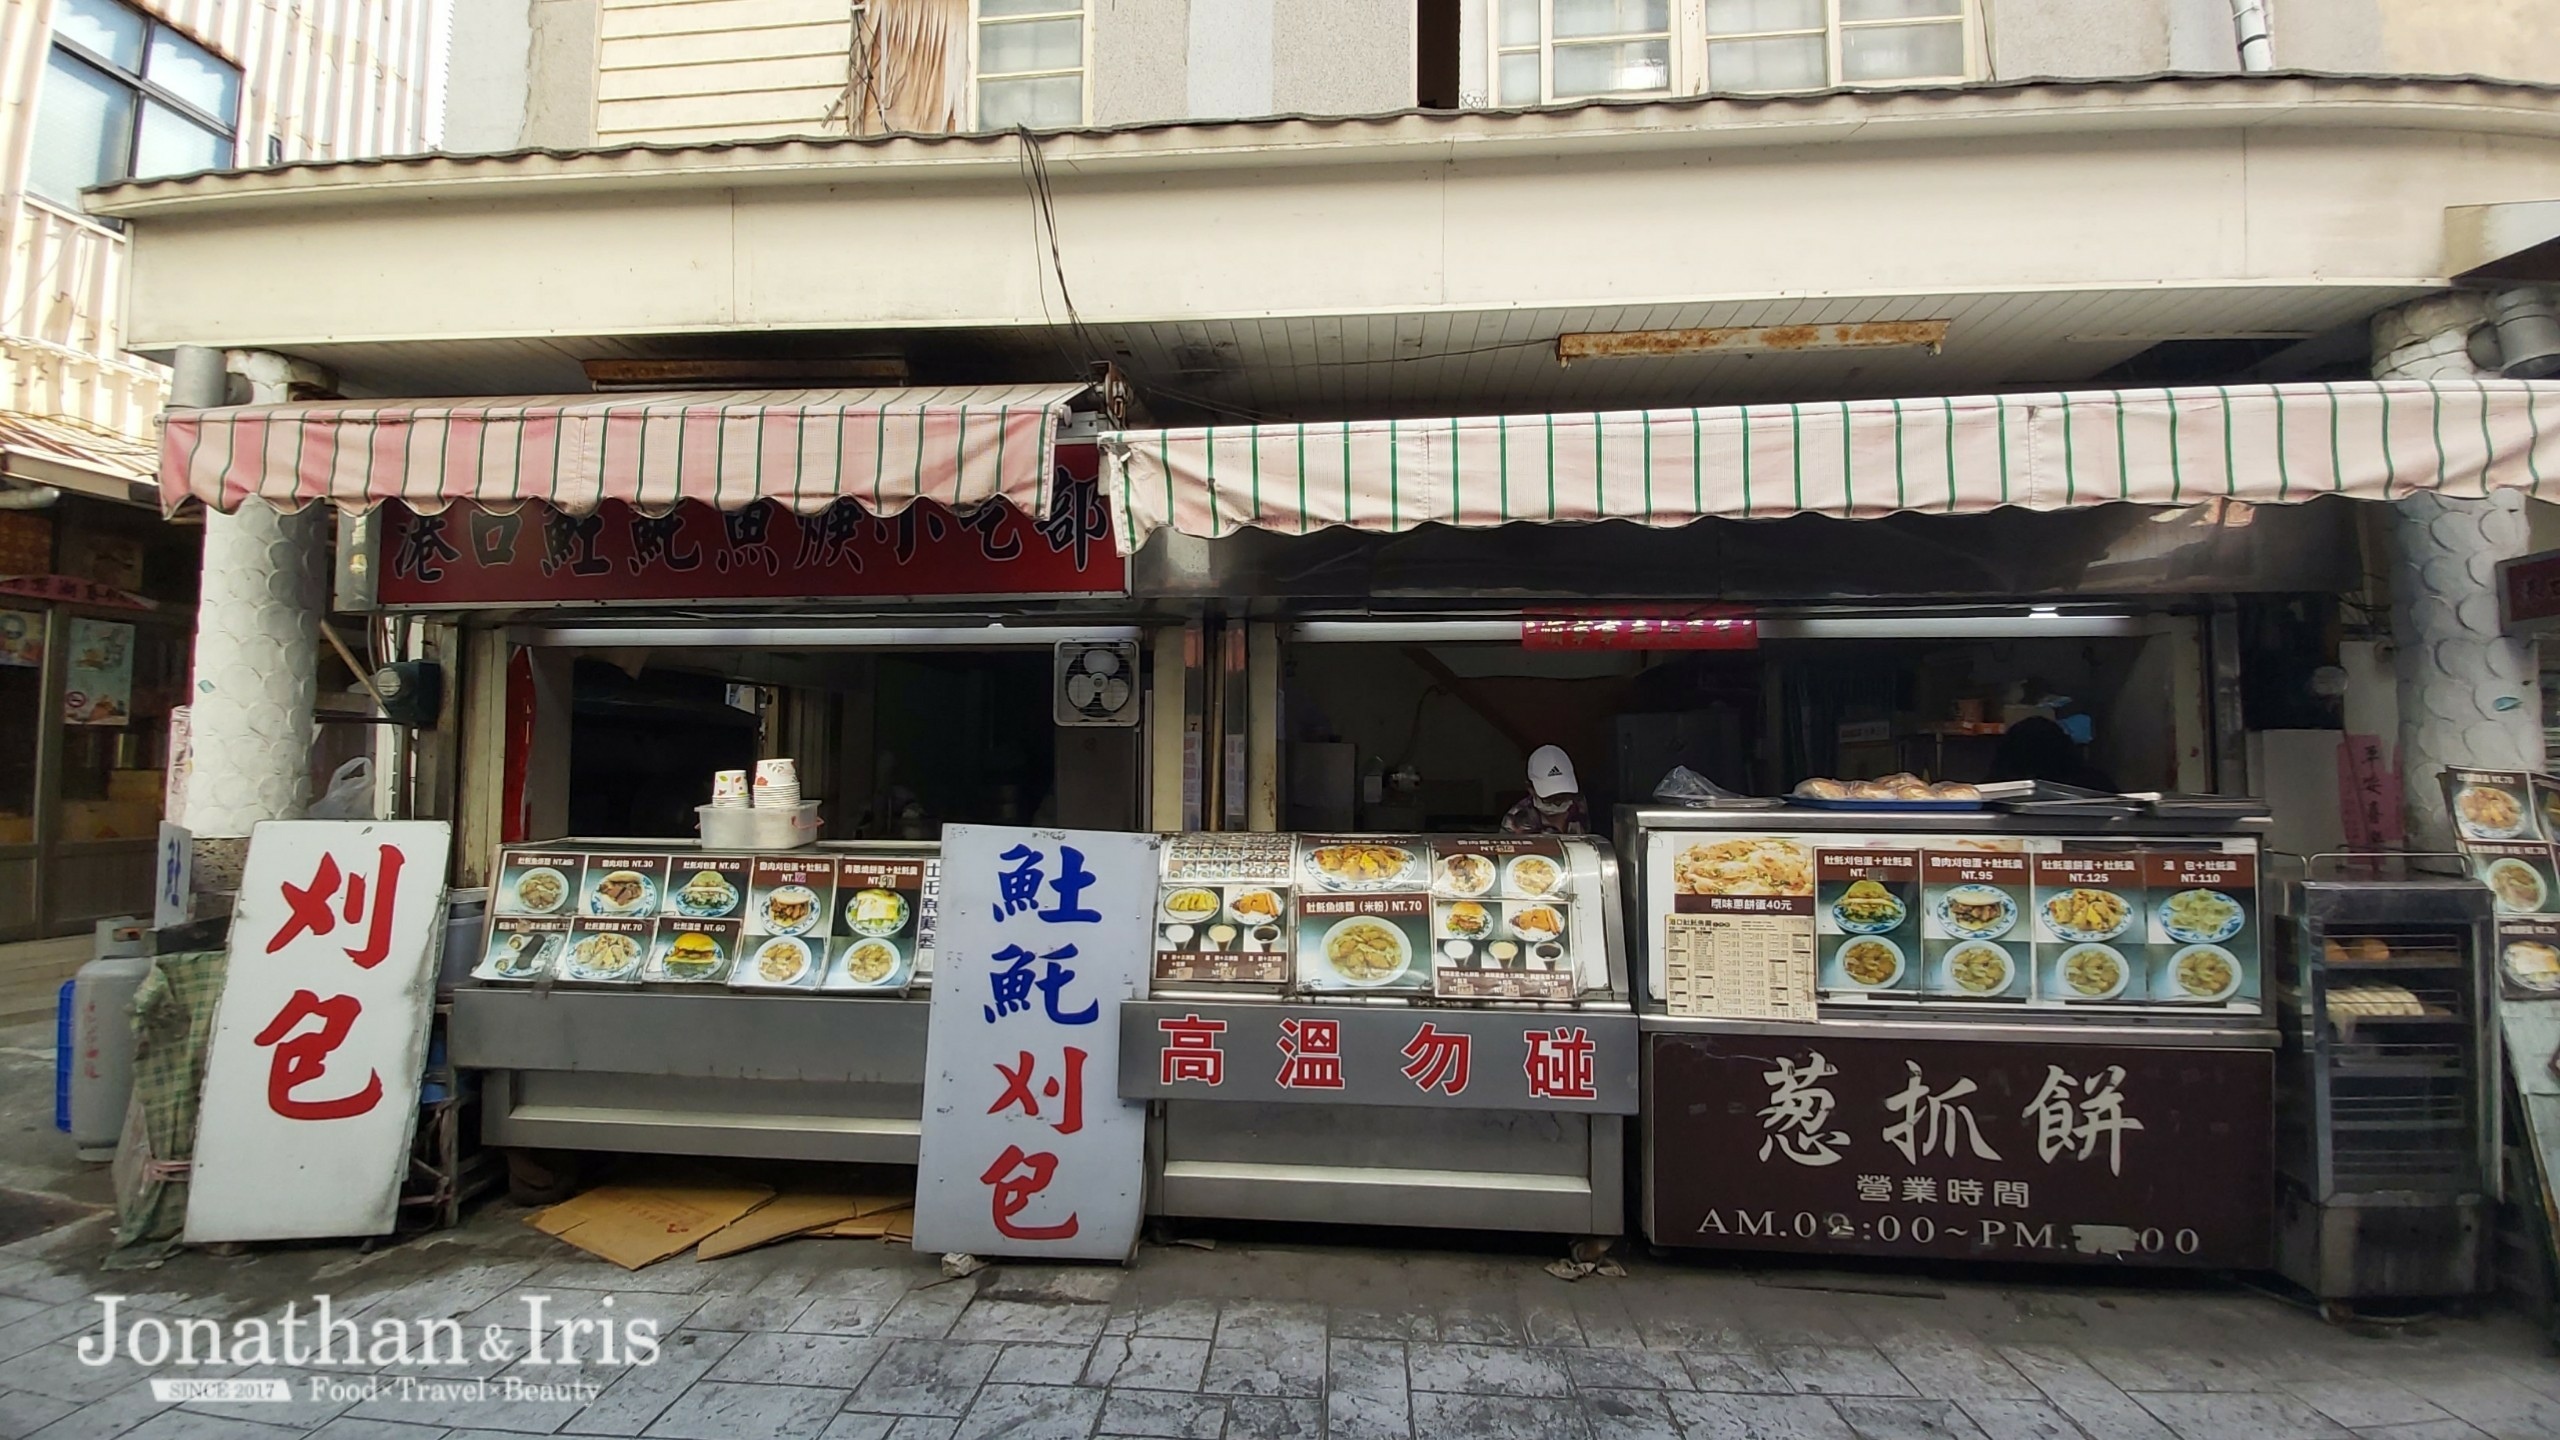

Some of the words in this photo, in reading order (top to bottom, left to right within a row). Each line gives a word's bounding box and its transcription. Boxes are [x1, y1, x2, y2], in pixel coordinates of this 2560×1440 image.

[632, 860, 653, 868] NT.30
[719, 862, 741, 870] NT.60
[1961, 871, 1994, 881] NT.95
[2069, 873, 2110, 883] NT.125
[2181, 873, 2221, 883] NT.110
[1392, 900, 1423, 911] NT.70
[621, 923, 643, 932] NT.70
[704, 923, 726, 933] NT.60
[254, 843, 406, 1121] 刈包
[1157, 1014, 1598, 1100] 高溫勿碰
[1857, 1174, 2031, 1209] 營業時間
